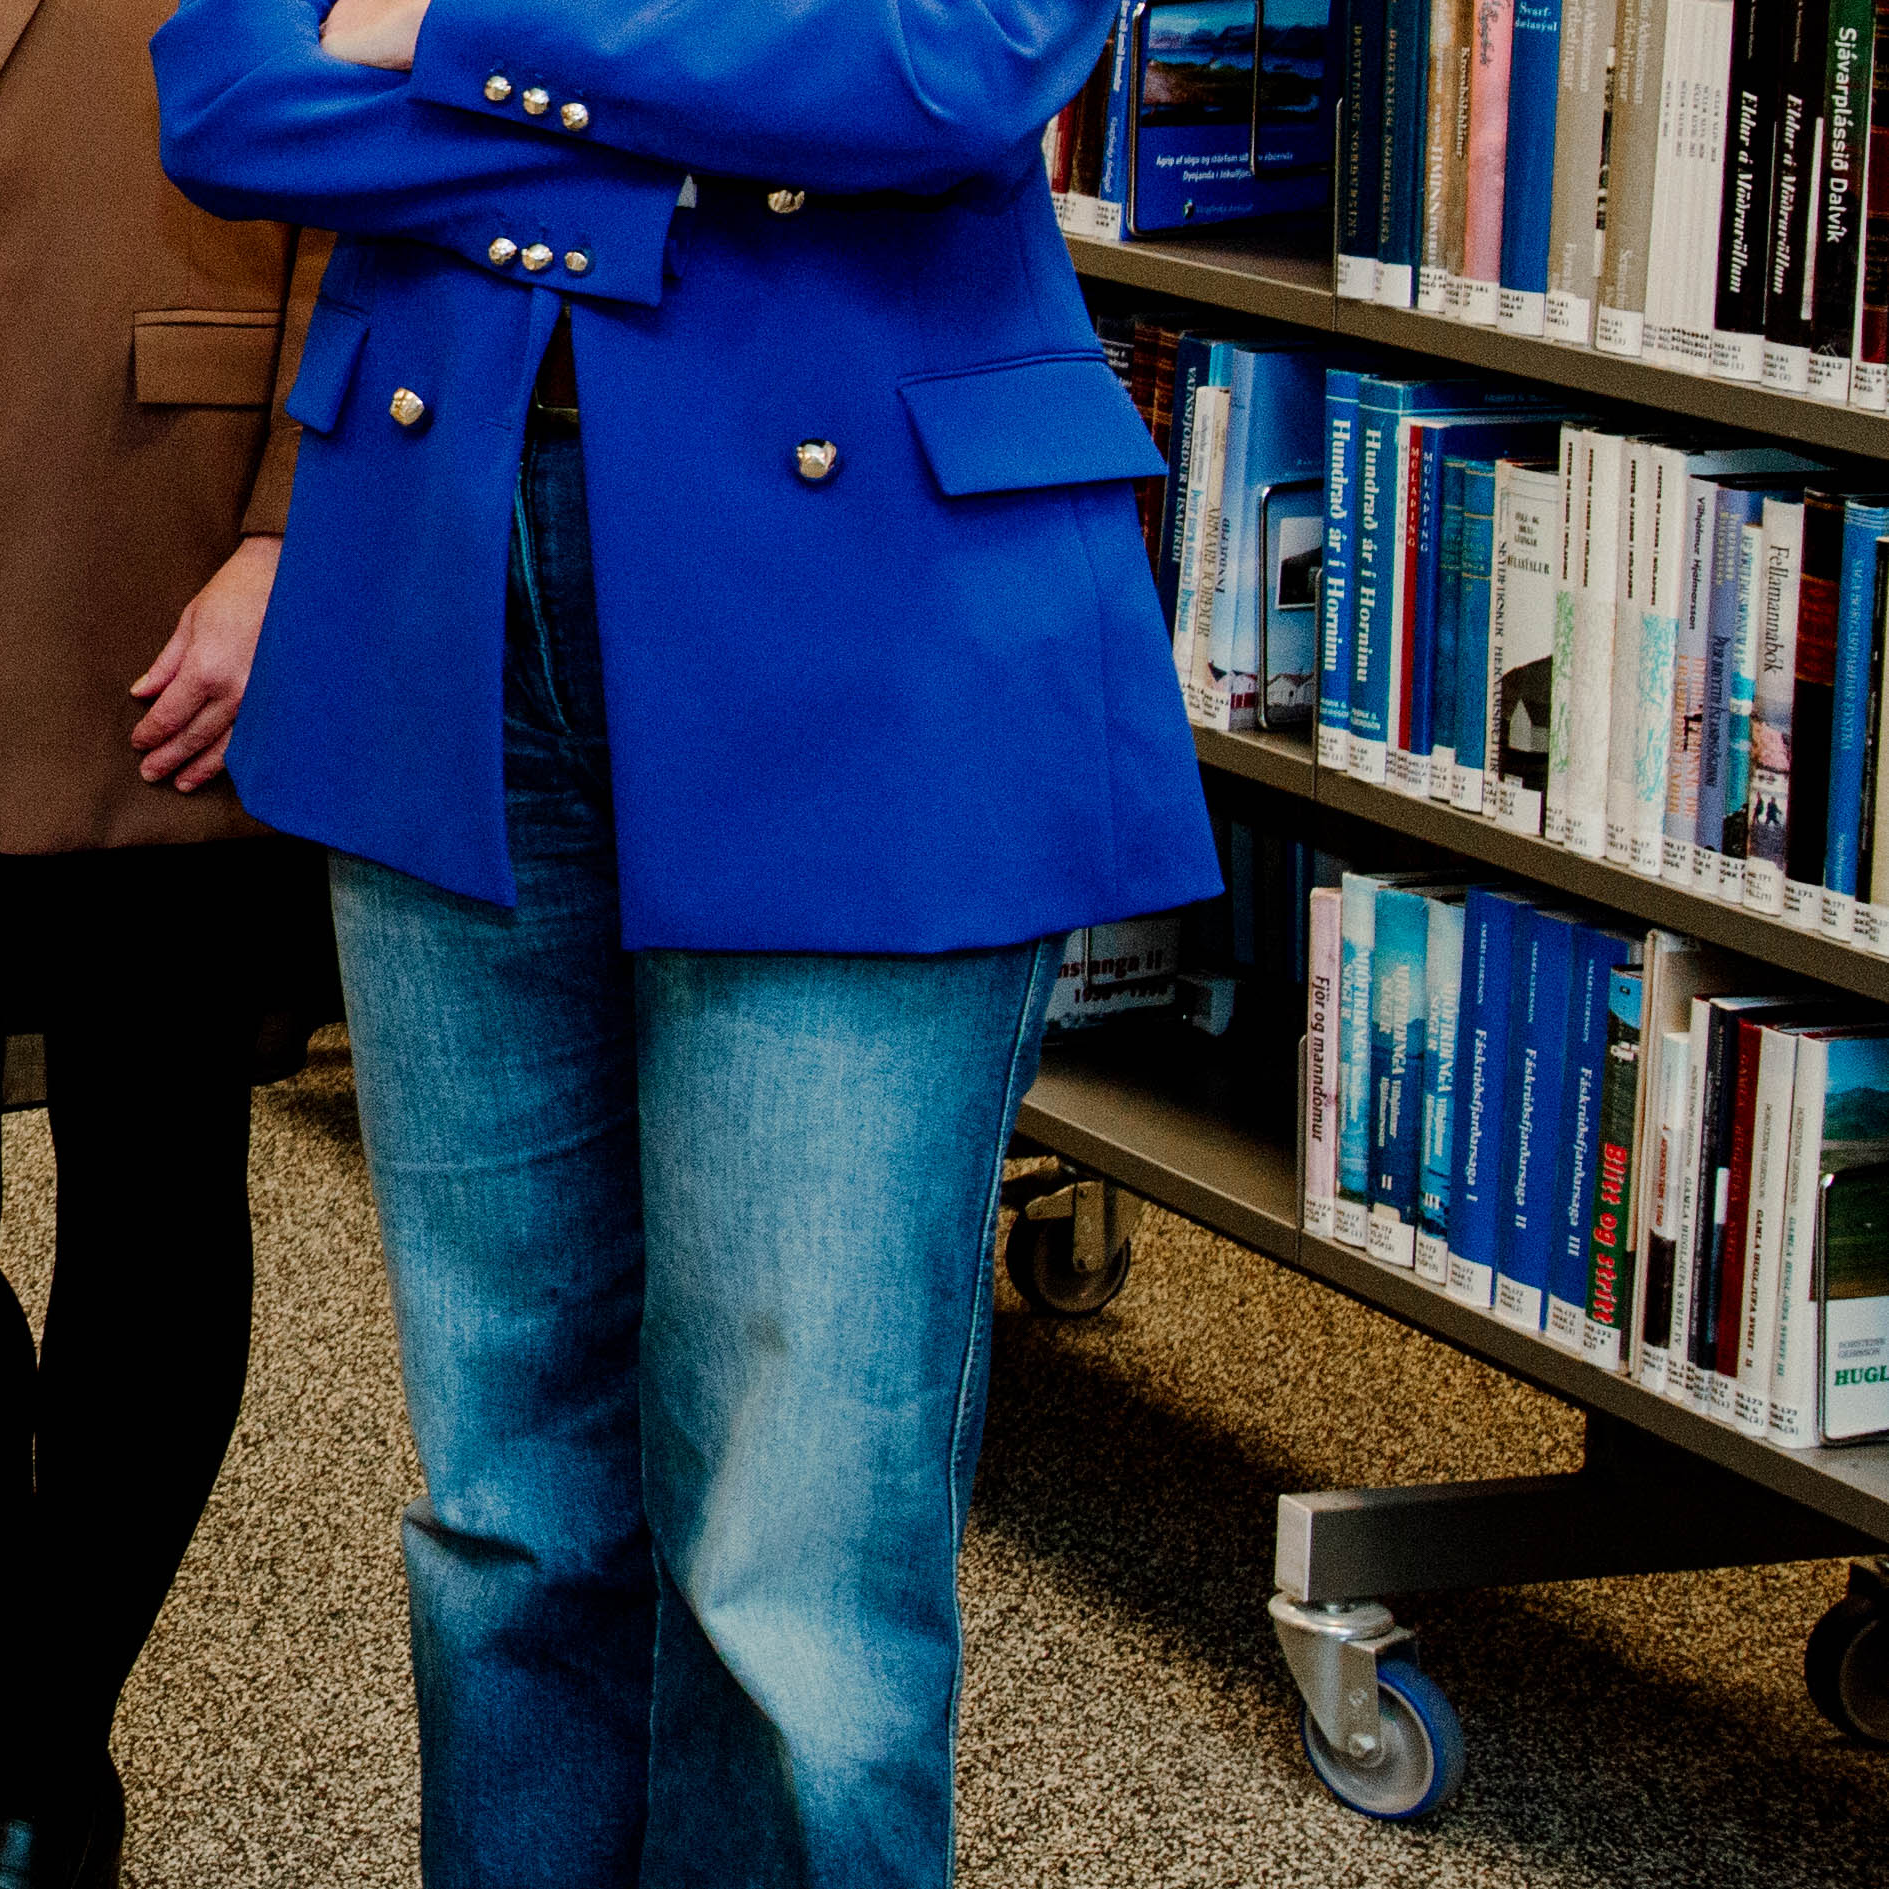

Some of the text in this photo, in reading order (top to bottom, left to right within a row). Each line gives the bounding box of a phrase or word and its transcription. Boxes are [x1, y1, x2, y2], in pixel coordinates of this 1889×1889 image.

[1728, 90, 1758, 294] Eldur Möðruvöllum
[1772, 94, 1803, 295] Eldur Möðruvöllum
[1825, 27, 1858, 244] Sjávarplássið Dalvík
[1323, 418, 1352, 672] Hundrað Horninu
[1356, 428, 1382, 683] Hundrað Horninu
[1763, 544, 1790, 674] Fellamannabók
[1311, 975, 1330, 1142] Fjör og manndómur
[1466, 1029, 1487, 1185] Fáskrúðsfjarðarsaga
[1515, 1047, 1538, 1206] Fáskrúðsfjarðarsaga
[1569, 1066, 1593, 1226] Fáskrúðsfjarðarsaga
[1594, 1213, 1619, 1246] og
[1753, 1209, 1765, 1249] GAMLA
